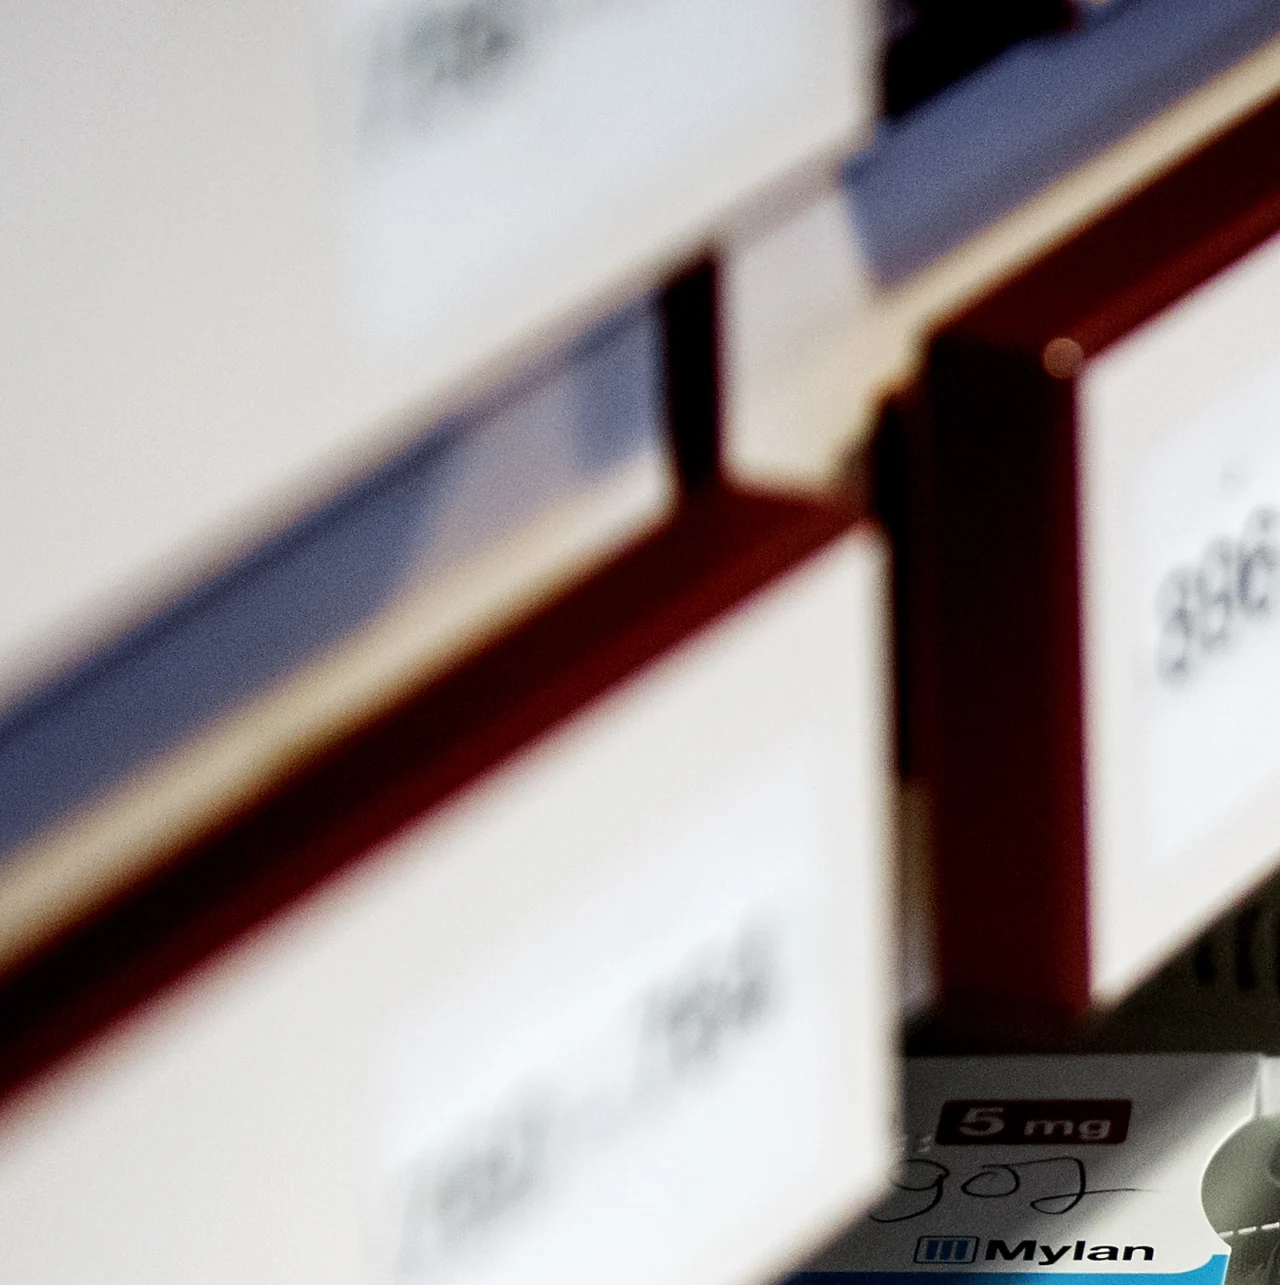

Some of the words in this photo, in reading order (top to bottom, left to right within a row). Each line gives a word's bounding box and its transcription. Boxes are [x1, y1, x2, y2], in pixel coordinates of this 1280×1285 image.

[958, 1105, 1005, 1137] 5
[1022, 1118, 1112, 1141] mg
[984, 1240, 1155, 1266] Mylan
